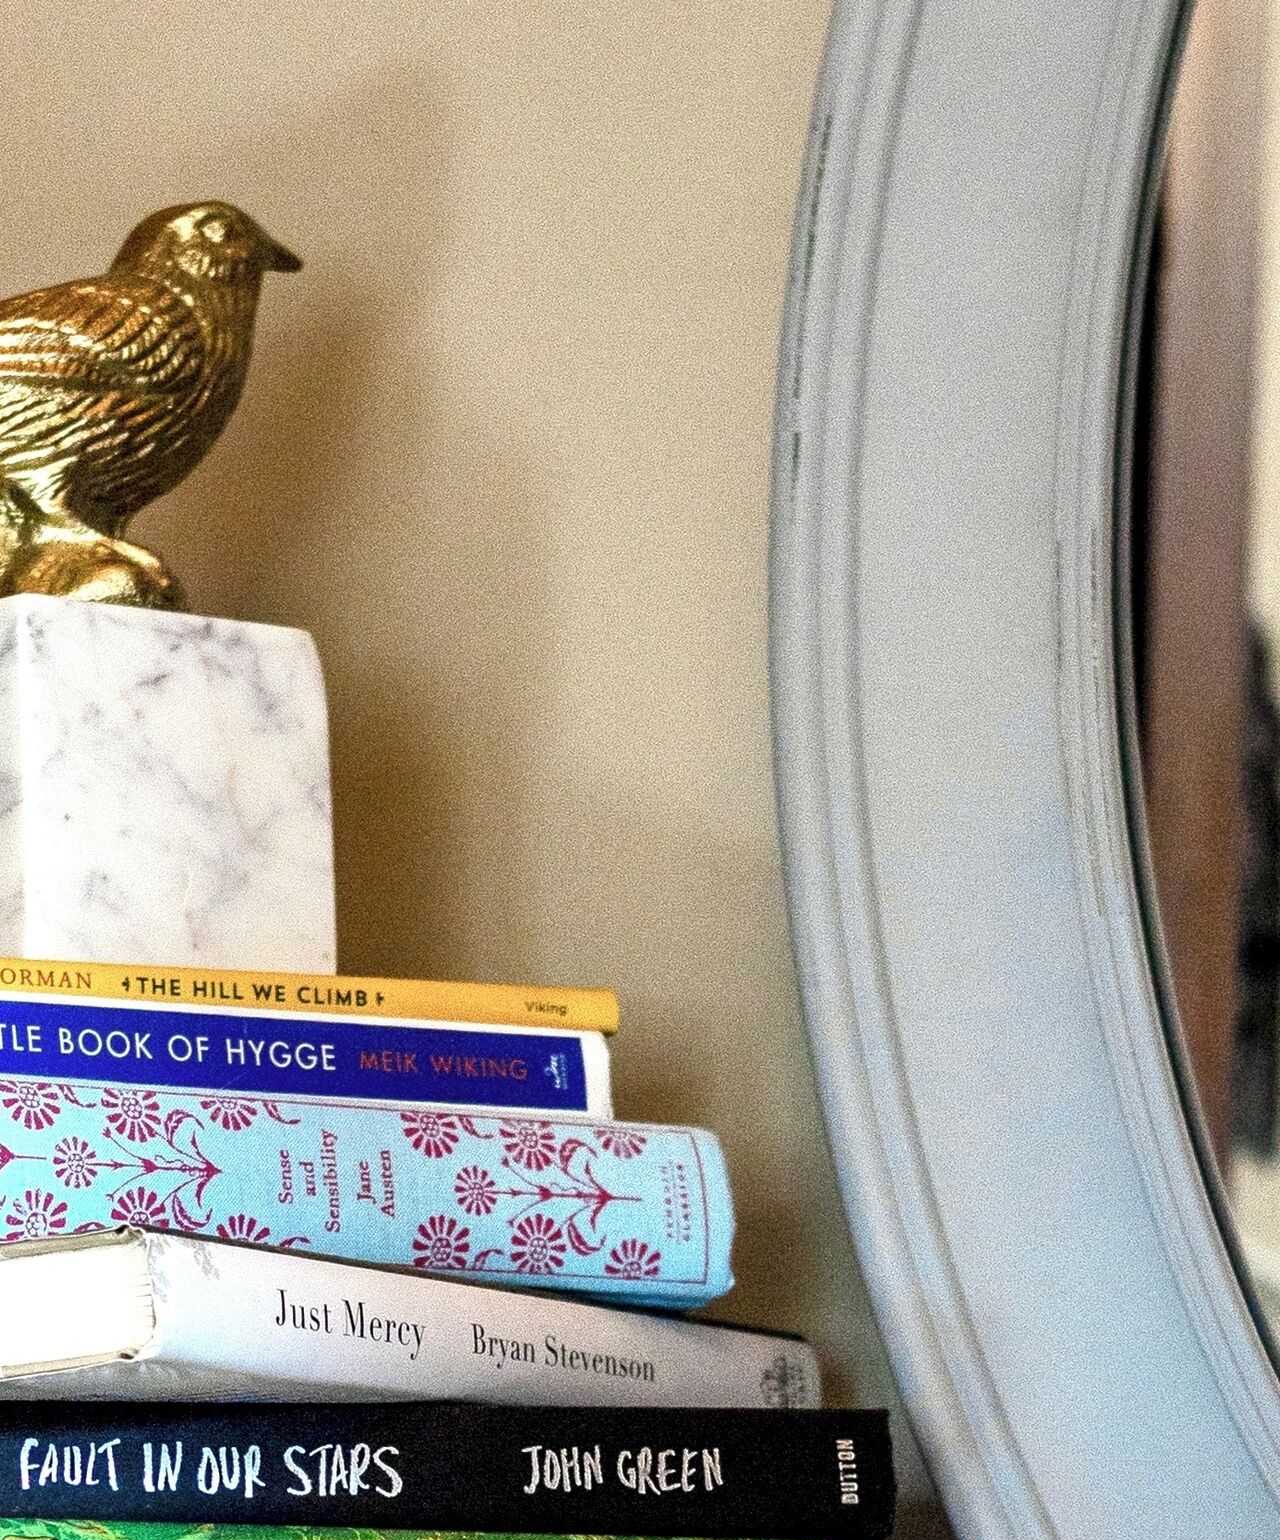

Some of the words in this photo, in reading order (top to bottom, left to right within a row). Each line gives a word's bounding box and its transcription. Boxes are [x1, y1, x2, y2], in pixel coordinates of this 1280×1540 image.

[136, 977, 181, 996] THE
[193, 981, 243, 1000] HILL
[252, 984, 286, 1002] WE
[297, 986, 368, 1007] CLIMB
[524, 1000, 568, 1017] Viking
[58, 1028, 153, 1060] BOOK
[168, 1035, 209, 1063] OF
[226, 1038, 336, 1071] HYGGE
[358, 1050, 418, 1074] MEIK
[430, 1055, 528, 1081] WIKING
[278, 1149, 294, 1204] Sense
[299, 1160, 317, 1197] and
[320, 1128, 340, 1233] Sensibility
[357, 1160, 377, 1204] Jane
[380, 1149, 396, 1218] Austen
[275, 1288, 333, 1334] Just
[341, 1299, 427, 1360] Mercy
[469, 1323, 536, 1369] Bryan
[543, 1335, 656, 1382] Stevenson
[19, 1437, 121, 1491] FAULT
[142, 1441, 183, 1494] IN
[197, 1444, 266, 1498] OUR
[283, 1443, 403, 1498] STARS
[521, 1445, 603, 1495] JOHN
[617, 1447, 724, 1495] GREEN
[836, 1438, 859, 1504] DUTTON
